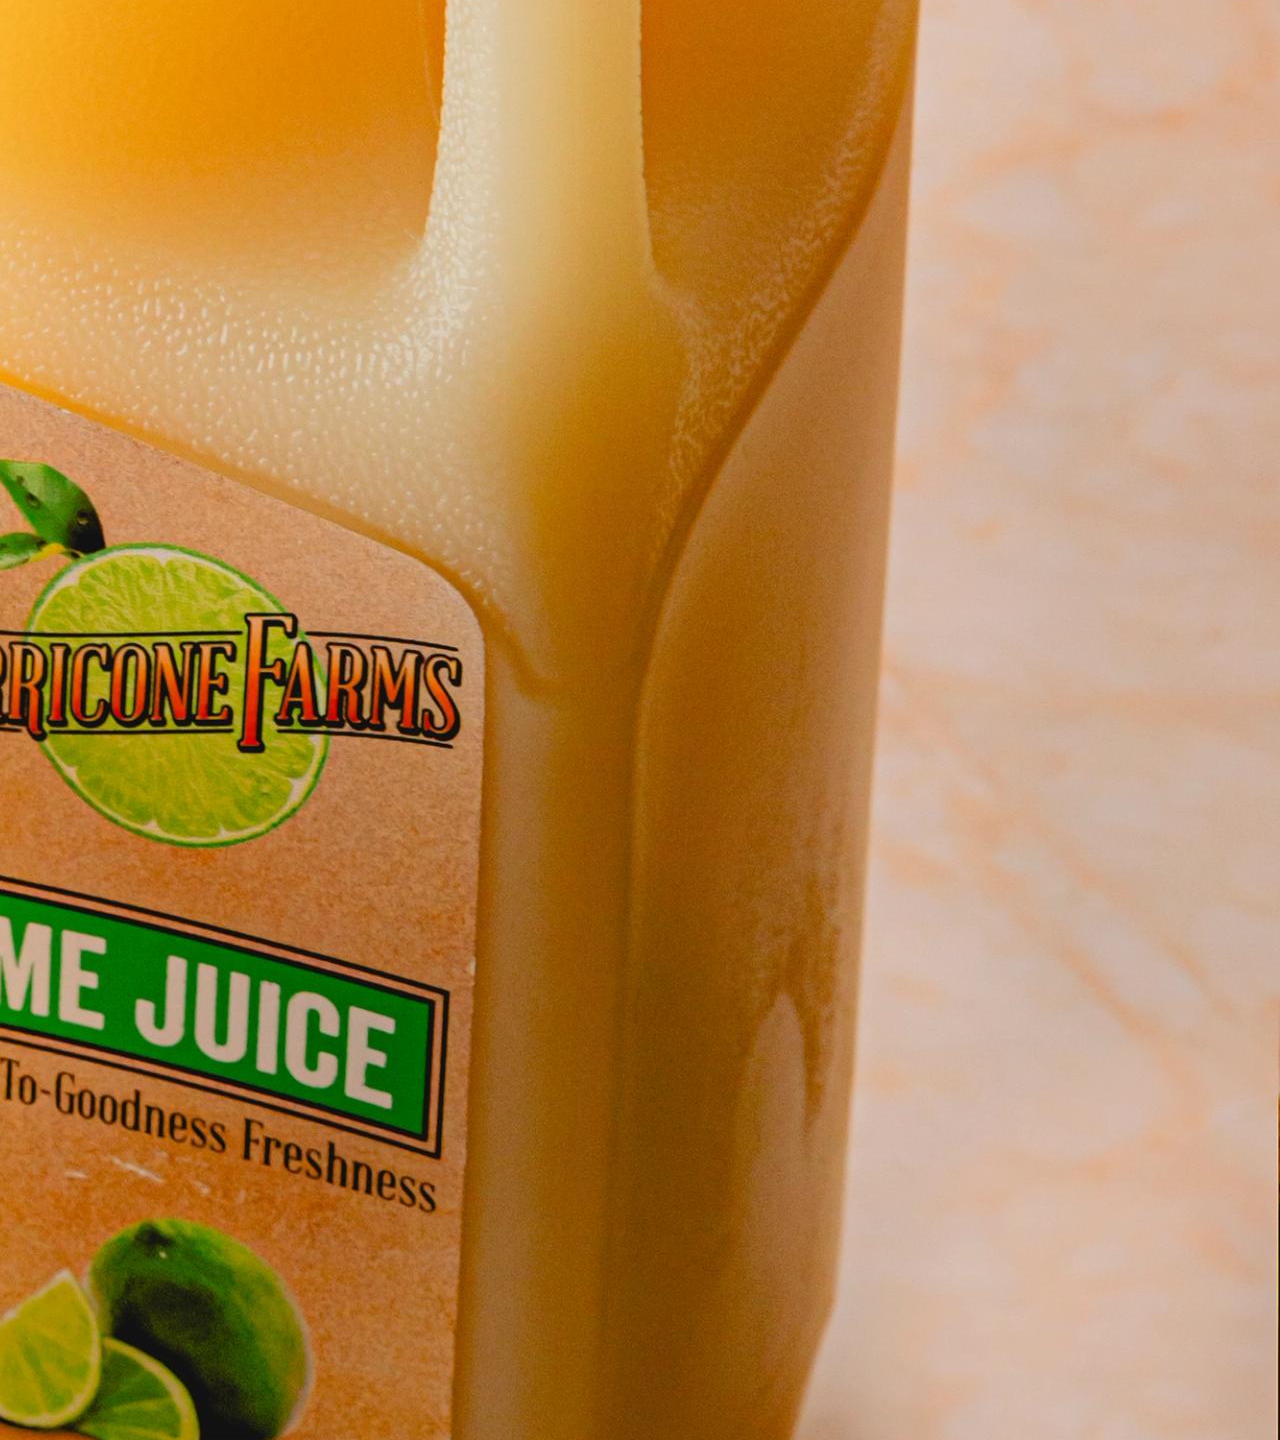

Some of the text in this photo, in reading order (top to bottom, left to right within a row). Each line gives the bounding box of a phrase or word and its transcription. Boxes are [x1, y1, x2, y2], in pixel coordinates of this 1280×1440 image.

[237, 612, 462, 754] FARMS
[134, 955, 396, 1110] JUICE
[241, 1117, 438, 1214] Freshness
